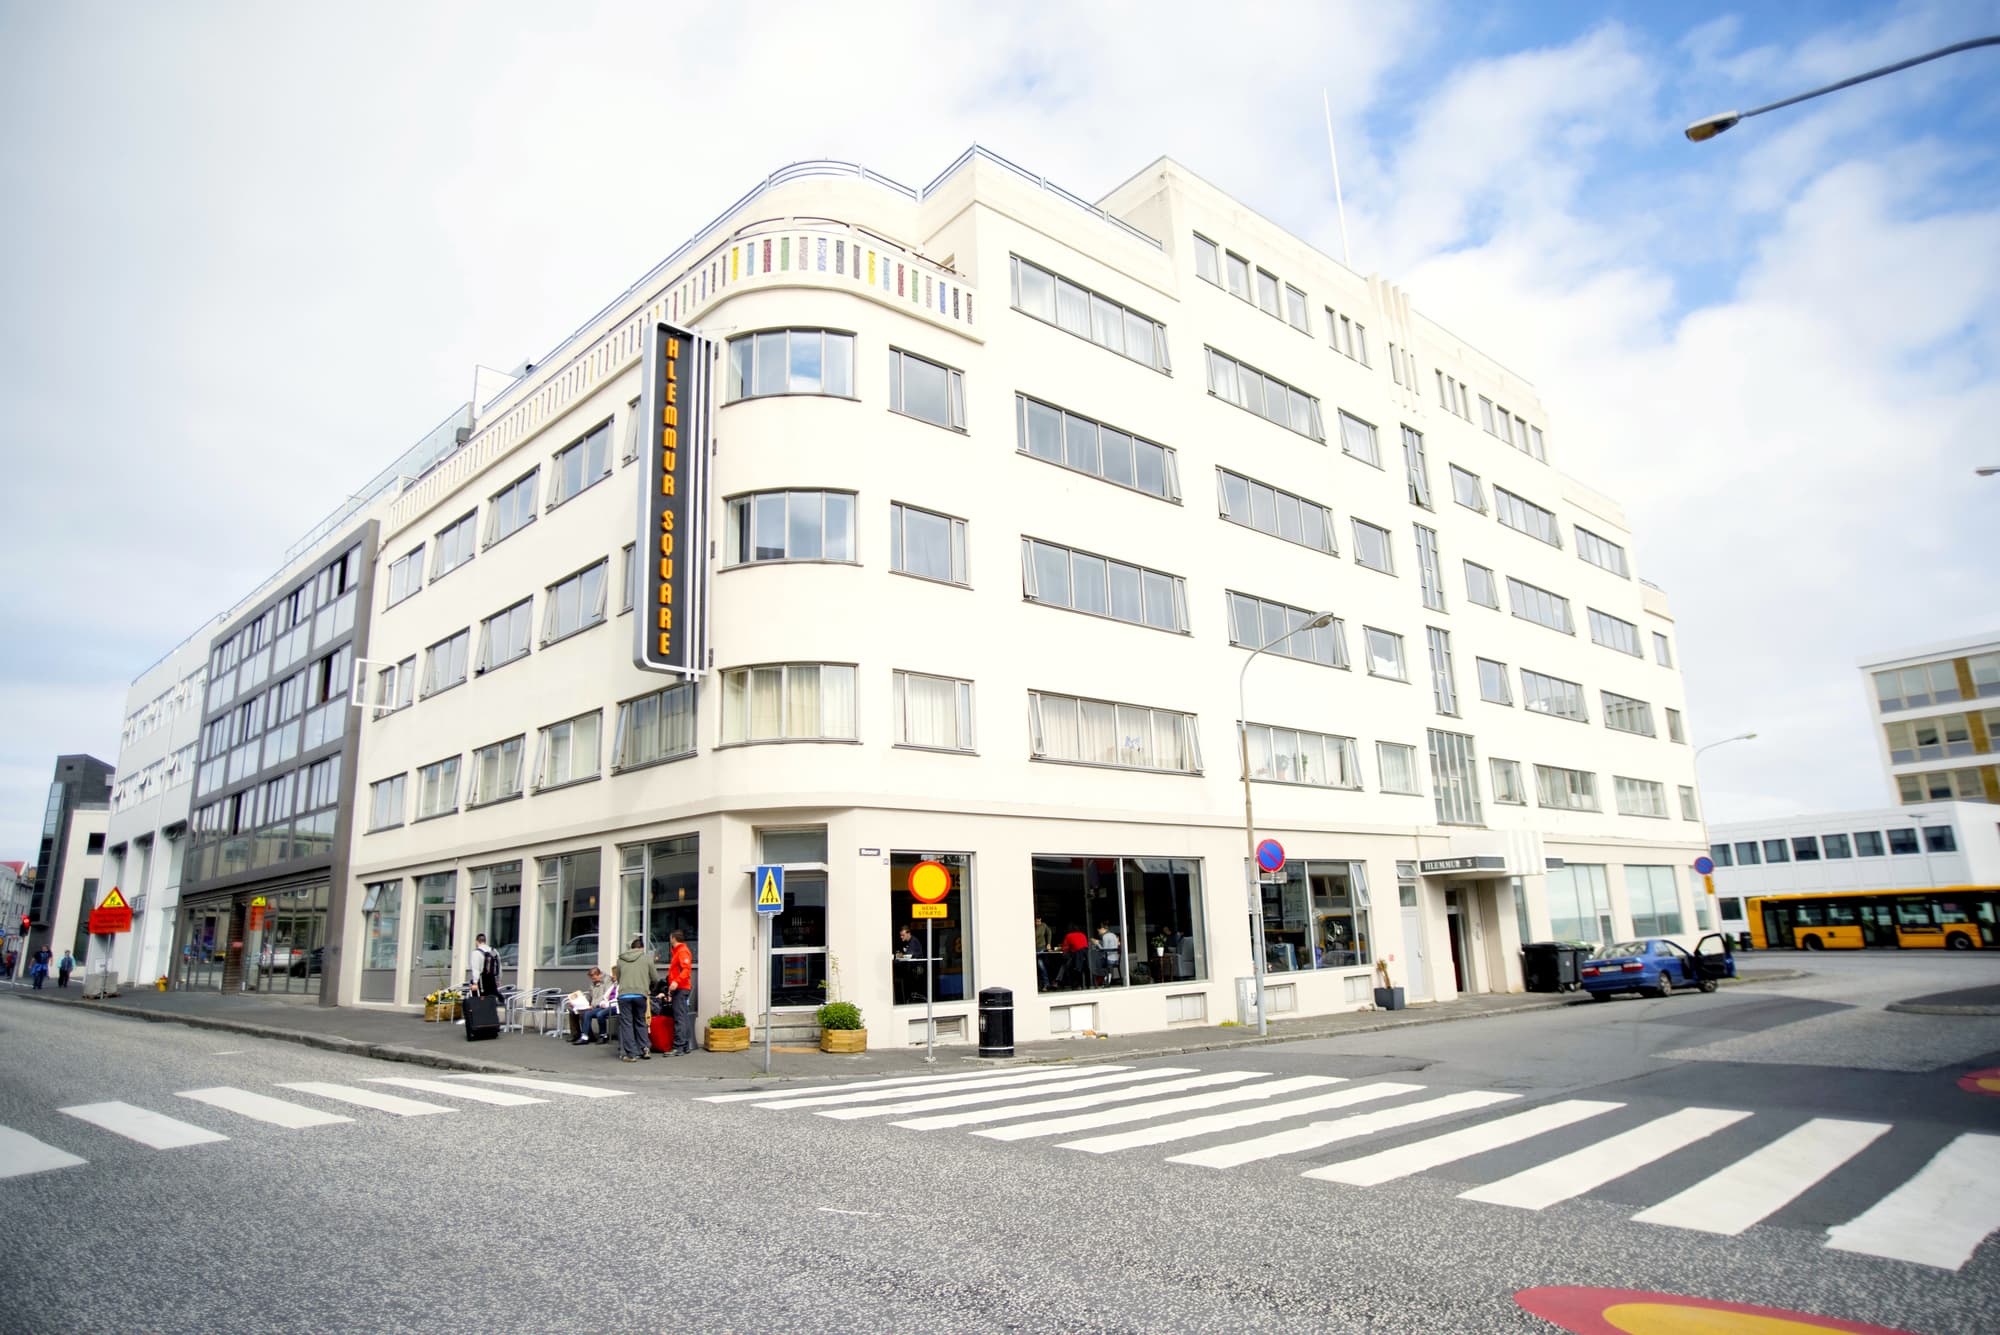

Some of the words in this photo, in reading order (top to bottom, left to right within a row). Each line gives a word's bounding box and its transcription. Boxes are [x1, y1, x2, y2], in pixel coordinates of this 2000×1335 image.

[661, 338, 679, 496] HLEMMUR
[658, 509, 675, 656] SQUARE
[1424, 860, 1461, 871] HLEMMUR
